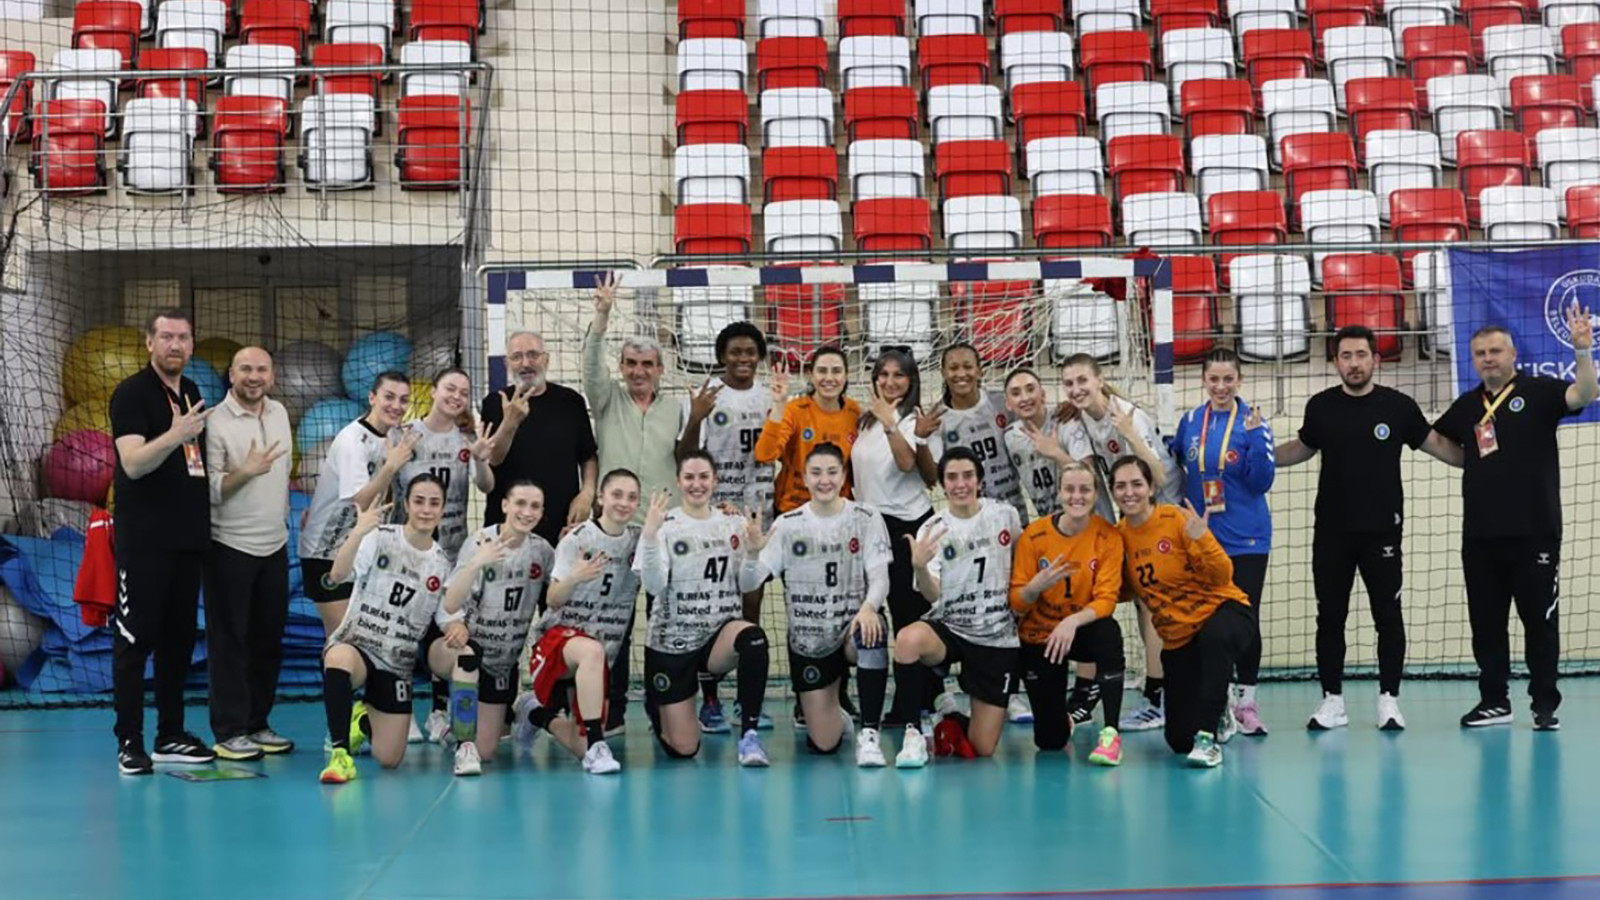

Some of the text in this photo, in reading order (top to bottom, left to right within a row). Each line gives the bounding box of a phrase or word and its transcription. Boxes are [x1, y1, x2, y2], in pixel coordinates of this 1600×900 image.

[971, 436, 998, 461] 99
[1033, 466, 1054, 490] 48
[703, 556, 729, 583] 47
[825, 562, 838, 587] 8
[973, 556, 987, 584] 7
[1136, 563, 1159, 588] 22
[388, 581, 416, 608] 87
[600, 573, 614, 596] 5
[1063, 575, 1073, 599] 1
[504, 586, 524, 612] 67
